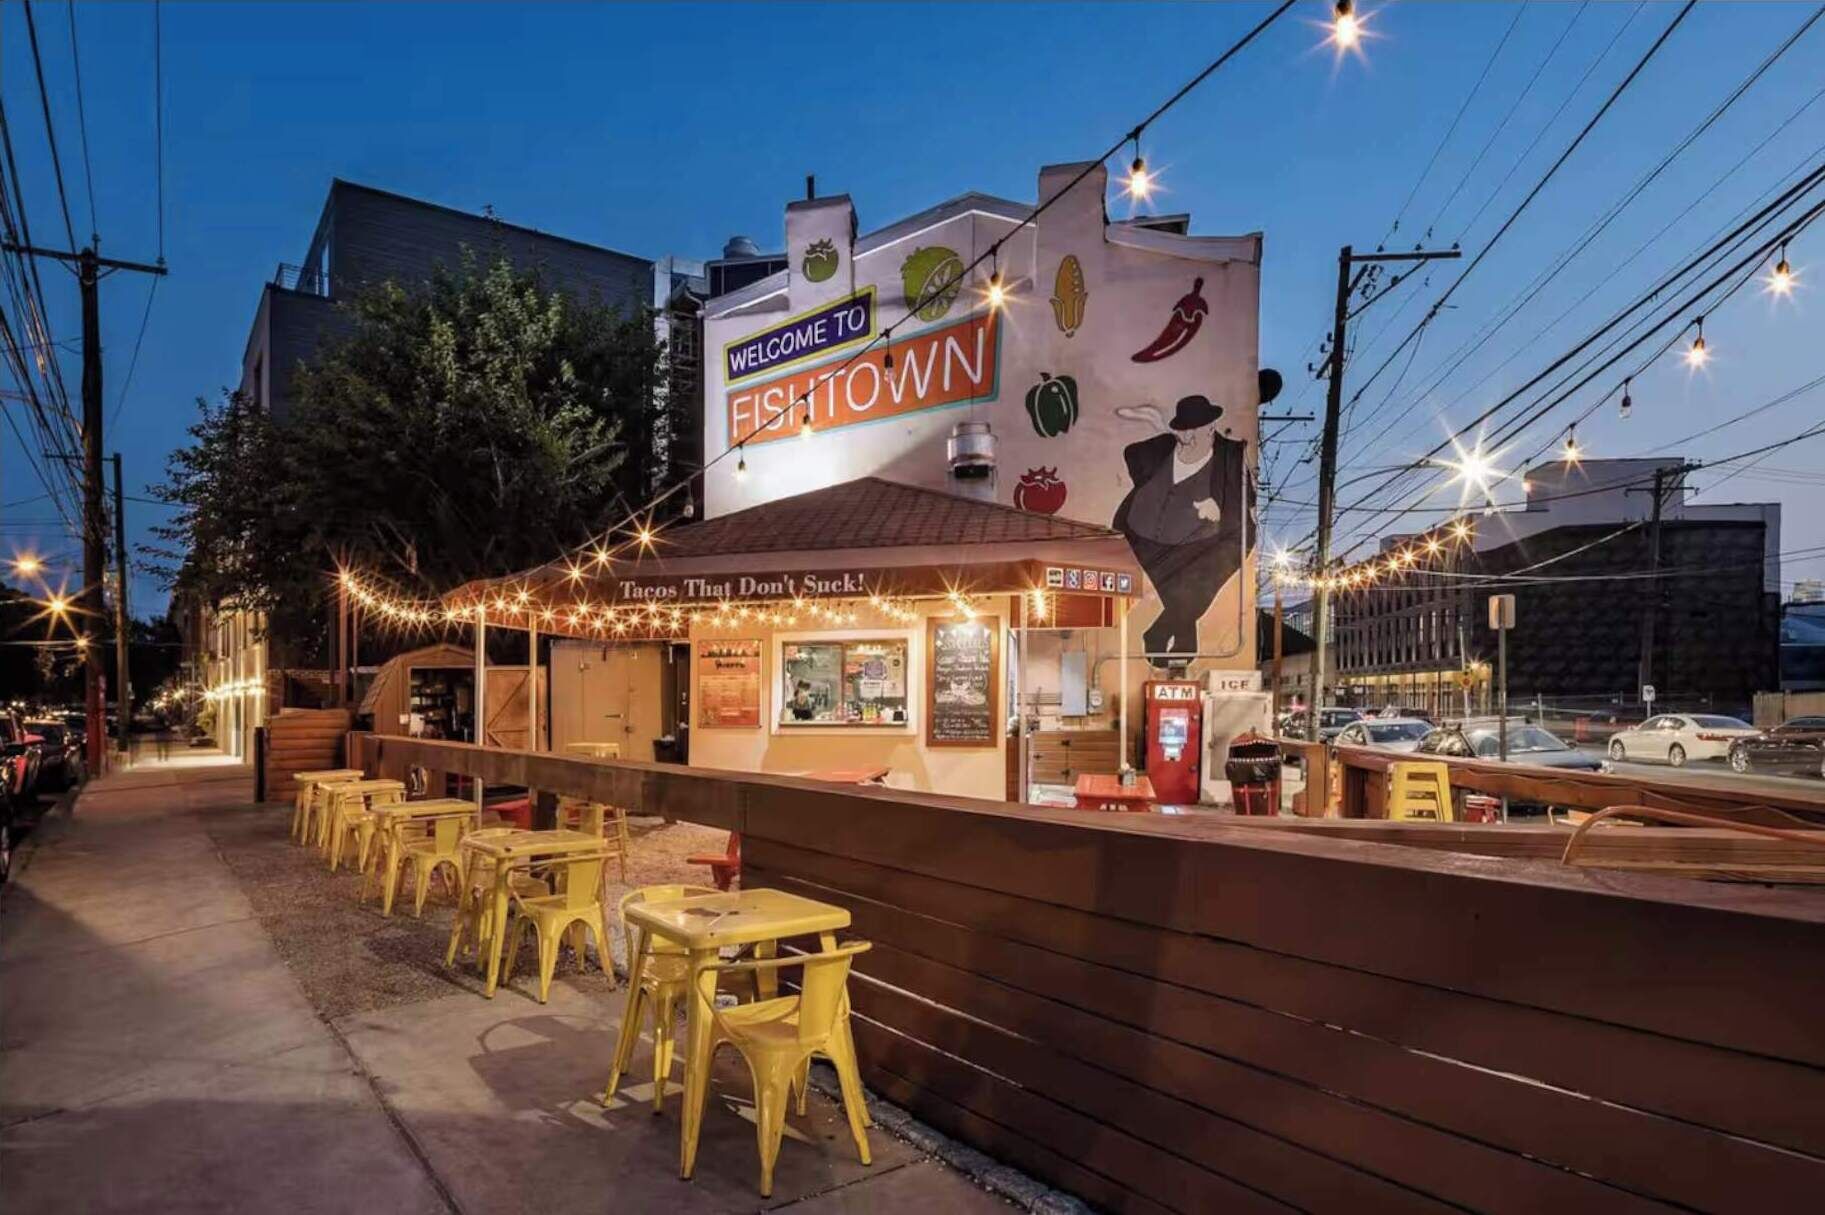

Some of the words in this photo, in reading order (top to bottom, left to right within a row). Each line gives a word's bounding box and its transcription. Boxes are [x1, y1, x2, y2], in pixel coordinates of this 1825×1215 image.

[730, 319, 827, 373] WELCOME
[833, 305, 866, 337] TO
[732, 326, 985, 439] FISHTOWN
[619, 580, 678, 600] Tacos
[684, 578, 731, 598] That
[739, 574, 796, 596] Don't
[803, 573, 865, 594] Suck!
[1158, 686, 1194, 699] ATM
